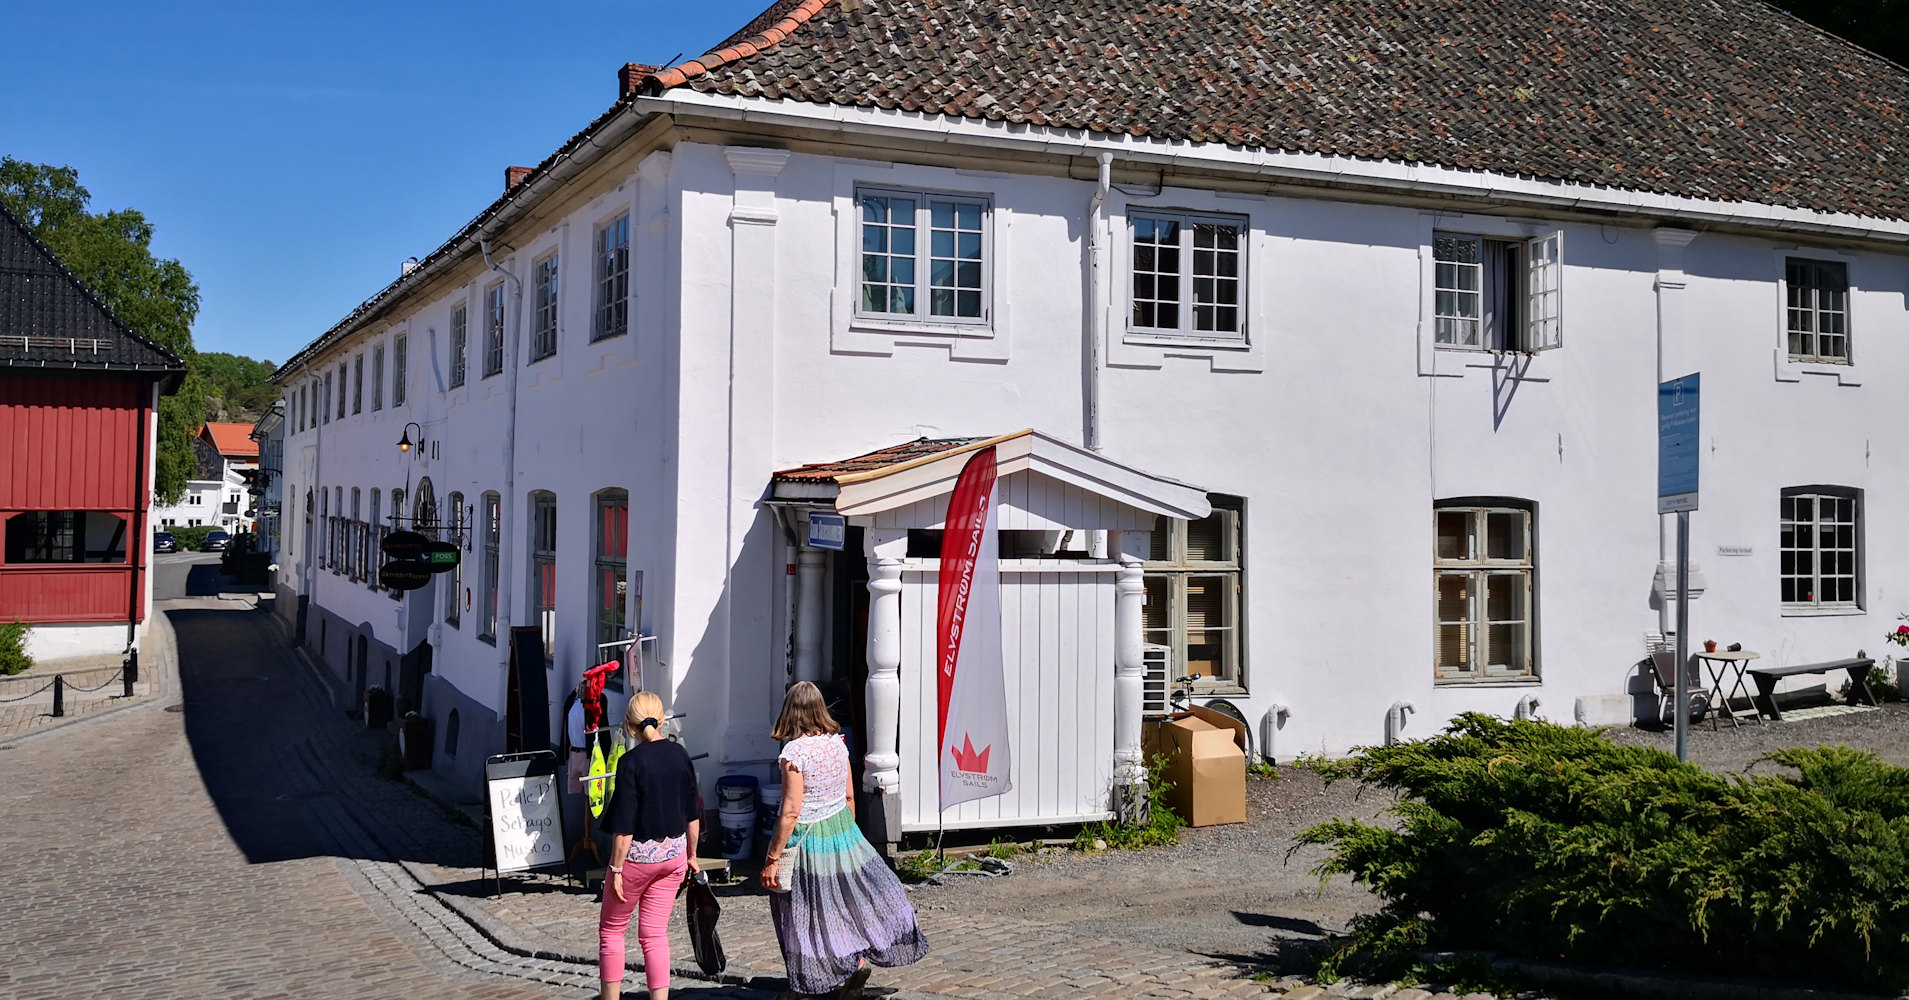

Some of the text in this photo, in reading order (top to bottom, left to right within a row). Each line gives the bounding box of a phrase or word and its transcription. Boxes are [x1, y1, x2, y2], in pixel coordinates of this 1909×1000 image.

[943, 560, 973, 678] ELVSTRØM
[951, 771, 998, 783] ELVSTRØM
[963, 780, 988, 788] SAILS
[501, 815, 552, 833] Sebago
